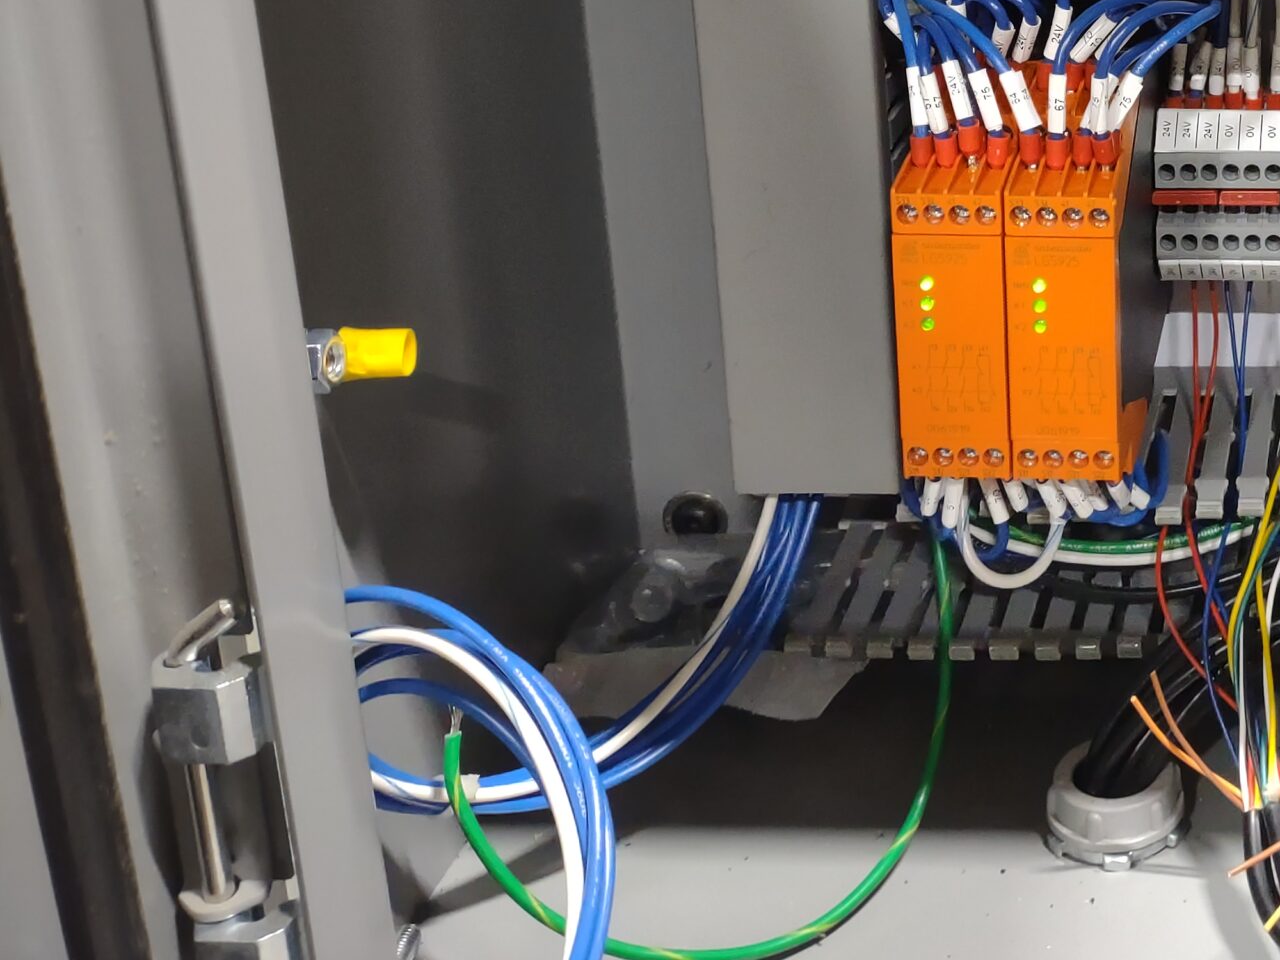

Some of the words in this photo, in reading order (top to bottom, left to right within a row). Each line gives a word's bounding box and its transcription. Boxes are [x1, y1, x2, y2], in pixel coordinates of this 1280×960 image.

[1051, 25, 1065, 44] 24V
[1054, 98, 1065, 111] 67
[1119, 96, 1132, 109] 75
[1162, 121, 1172, 137] 24V
[1182, 121, 1192, 138] 24V
[1203, 122, 1213, 139] 24V
[1224, 124, 1234, 138] 0V
[1246, 125, 1255, 138] 0V
[1267, 125, 1277, 138] 0V
